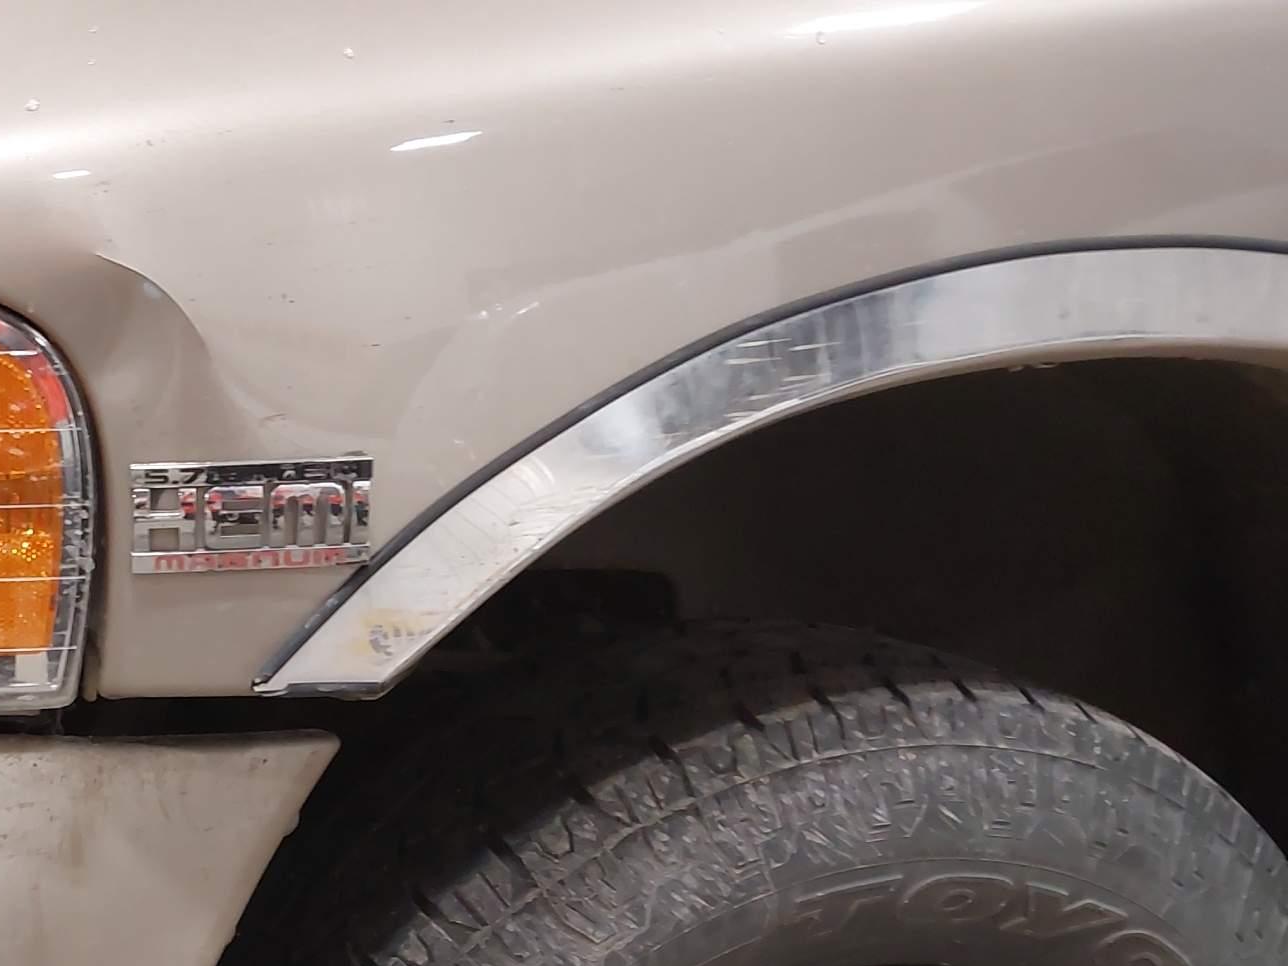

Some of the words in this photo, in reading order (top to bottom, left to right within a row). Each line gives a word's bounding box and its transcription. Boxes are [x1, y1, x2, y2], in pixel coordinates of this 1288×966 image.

[143, 467, 204, 485] 5.7
[131, 480, 371, 552] HEMI
[152, 549, 347, 572] MAGNUM
